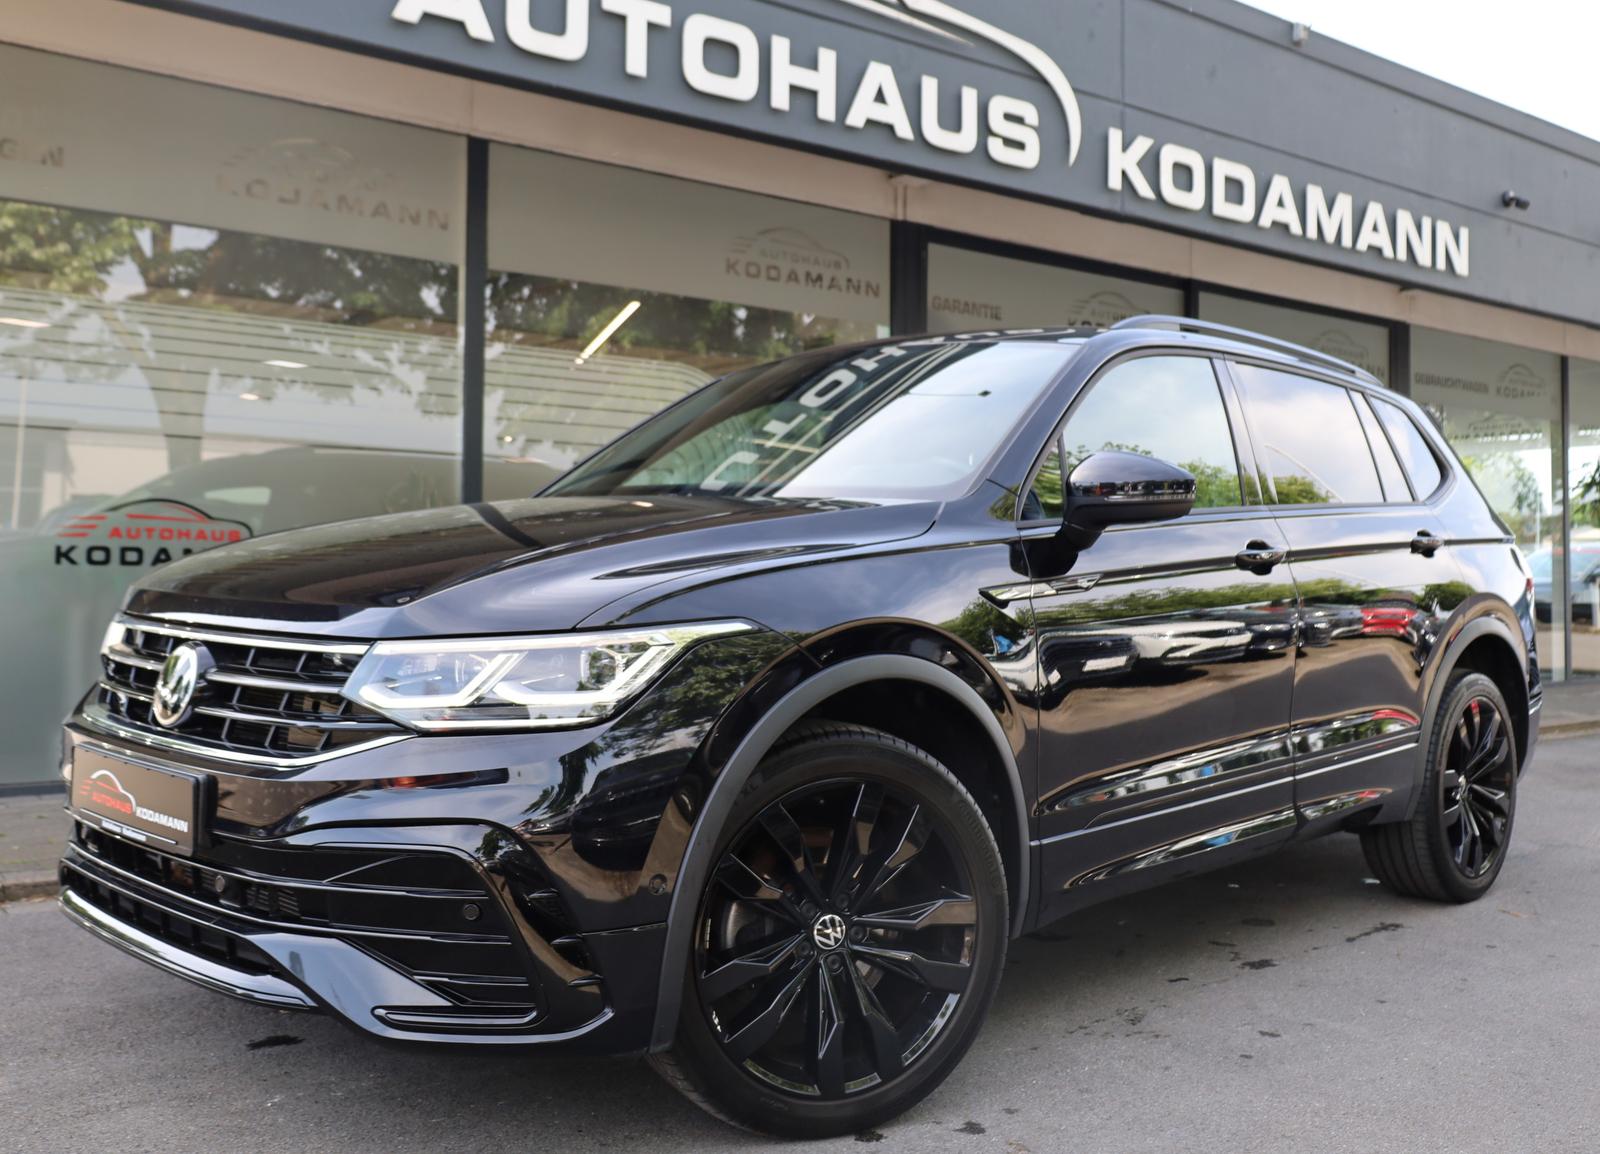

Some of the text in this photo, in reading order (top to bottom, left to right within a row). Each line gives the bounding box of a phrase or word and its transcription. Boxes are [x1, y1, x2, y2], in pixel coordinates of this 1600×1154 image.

[1106, 126, 1470, 277] KODAMANN
[725, 257, 881, 299] KODAMANN
[931, 295, 1003, 321] GARANTIE
[107, 526, 242, 542] AUTOHAUS
[54, 544, 196, 567] KODA
